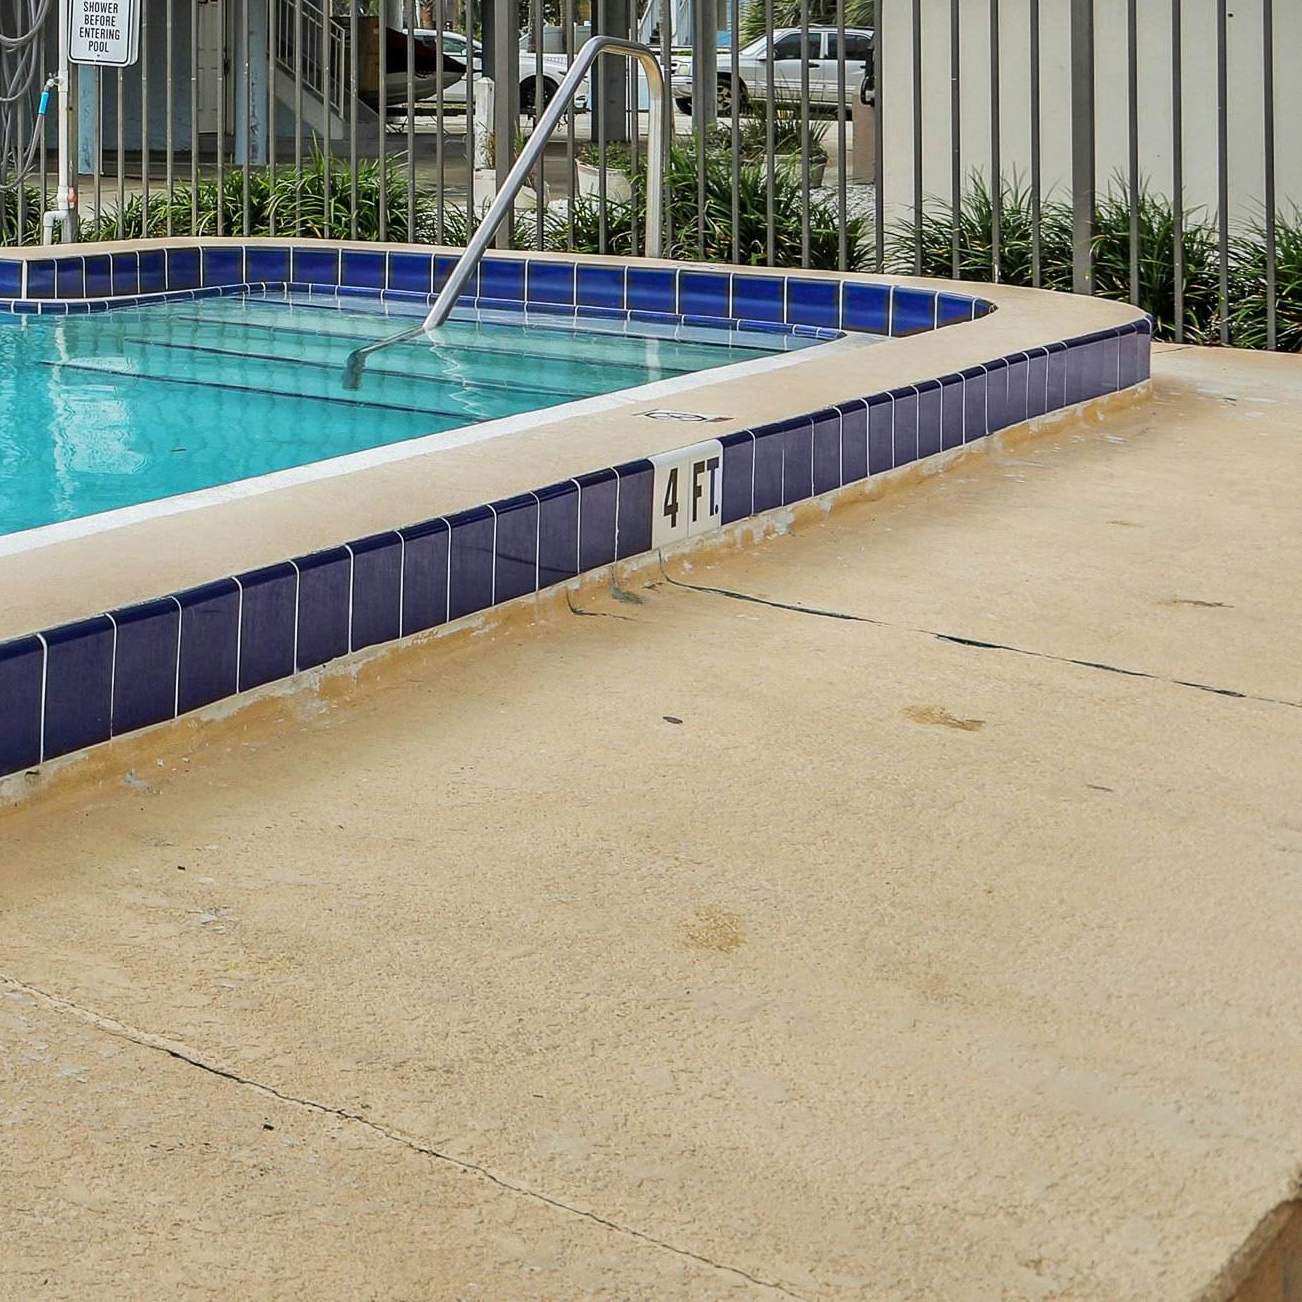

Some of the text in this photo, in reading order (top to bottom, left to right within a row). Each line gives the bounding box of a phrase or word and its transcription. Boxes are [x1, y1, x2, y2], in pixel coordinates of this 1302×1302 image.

[84, 2, 118, 14] SHOWER
[84, 14, 116, 27] BEFORE
[80, 27, 120, 40] ENTERING
[88, 41, 109, 52] POOL
[664, 457, 720, 528] 4 FT.
